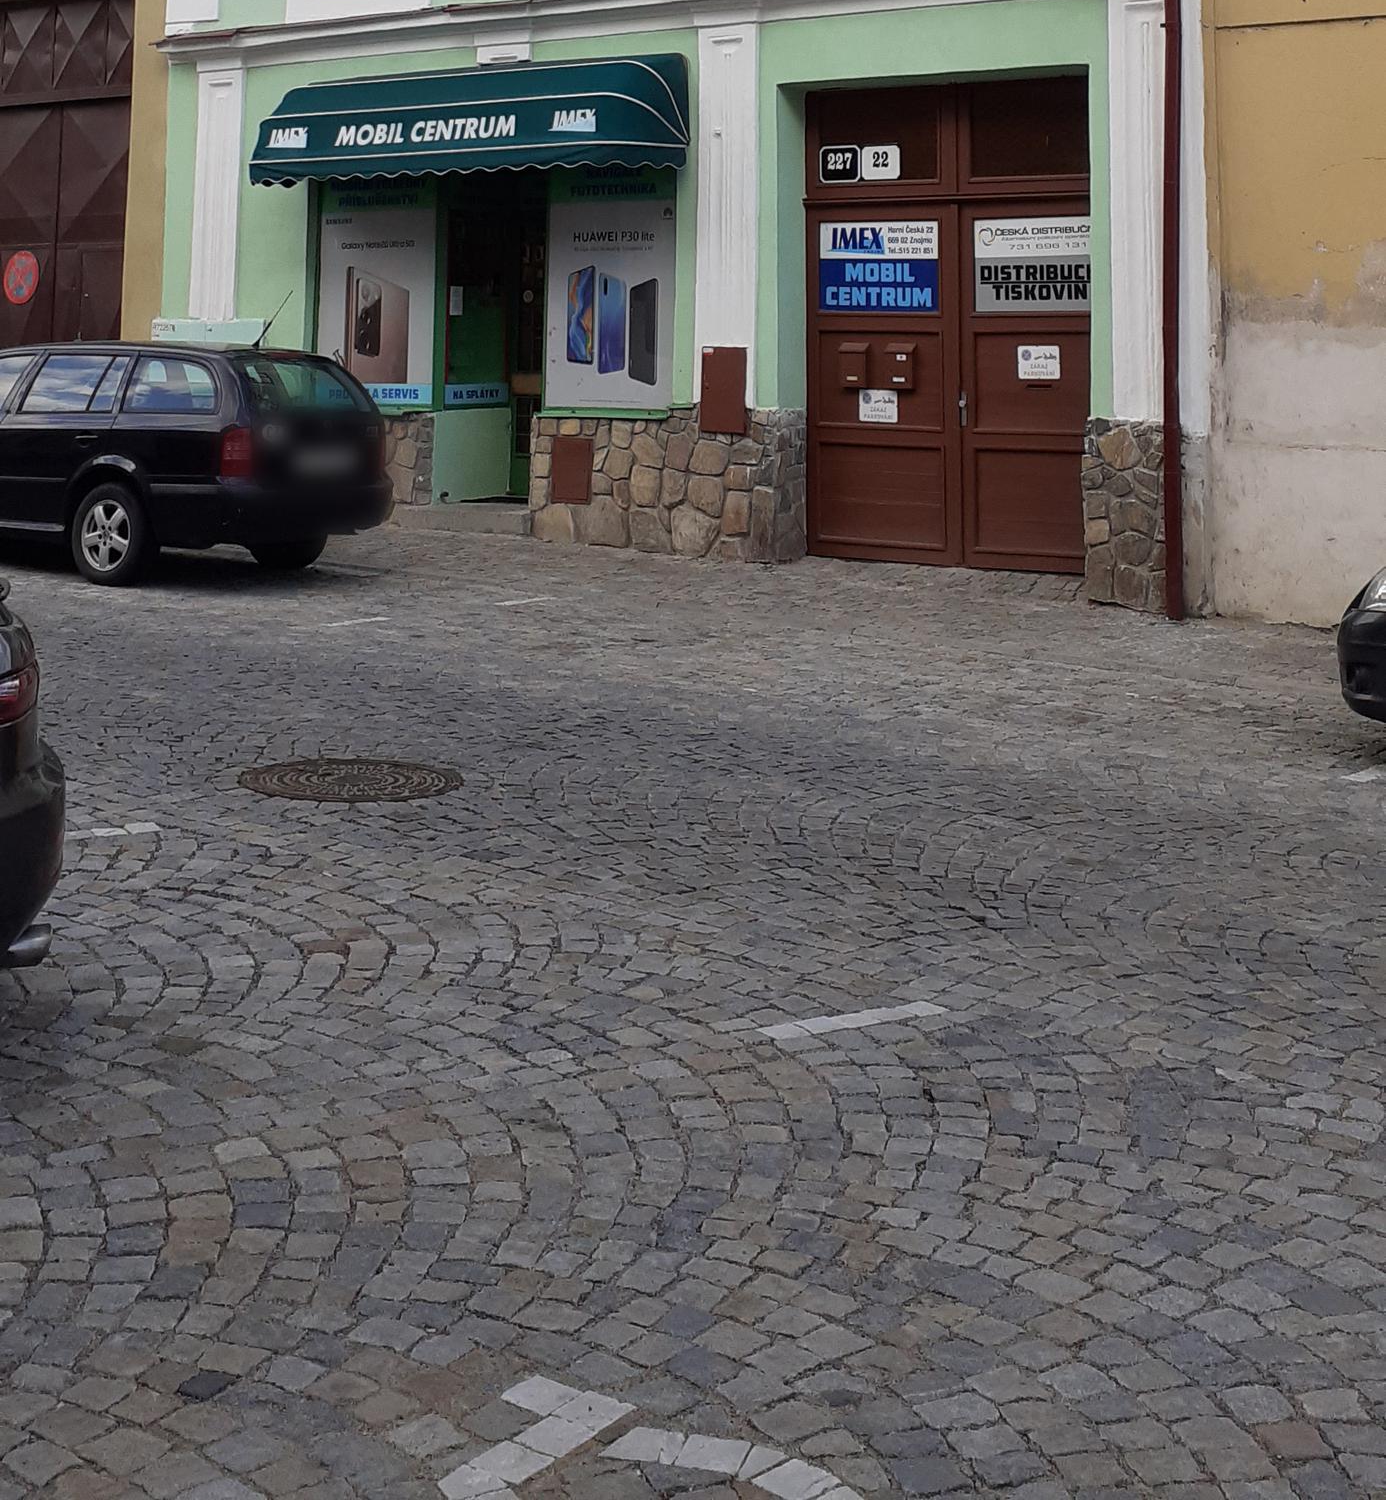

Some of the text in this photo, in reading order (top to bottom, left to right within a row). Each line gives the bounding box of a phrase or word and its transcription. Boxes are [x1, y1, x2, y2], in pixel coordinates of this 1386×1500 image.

[334, 123, 404, 147] MOBIL
[410, 115, 516, 142] CENTRUM
[827, 151, 889, 170] 227 22
[905, 225, 925, 234] Česká
[925, 226, 934, 234] 22
[994, 226, 1029, 237] ČESKÁ
[573, 230, 656, 243] HUAWEI P30 lite
[831, 227, 883, 250] IMEX
[900, 236, 908, 244] 02
[909, 236, 933, 246] Znojmo
[341, 242, 365, 251] Galaxy
[911, 247, 921, 255] 221
[1009, 243, 1031, 251] 731
[1065, 241, 1087, 249] 131
[845, 263, 915, 283] MOBIL
[825, 286, 933, 307] CENTRUM
[992, 283, 1088, 301] TISKOVIN
[372, 388, 379, 399] A
[381, 388, 419, 399] SERVIS
[453, 388, 500, 400] NA SPLÁTKY
